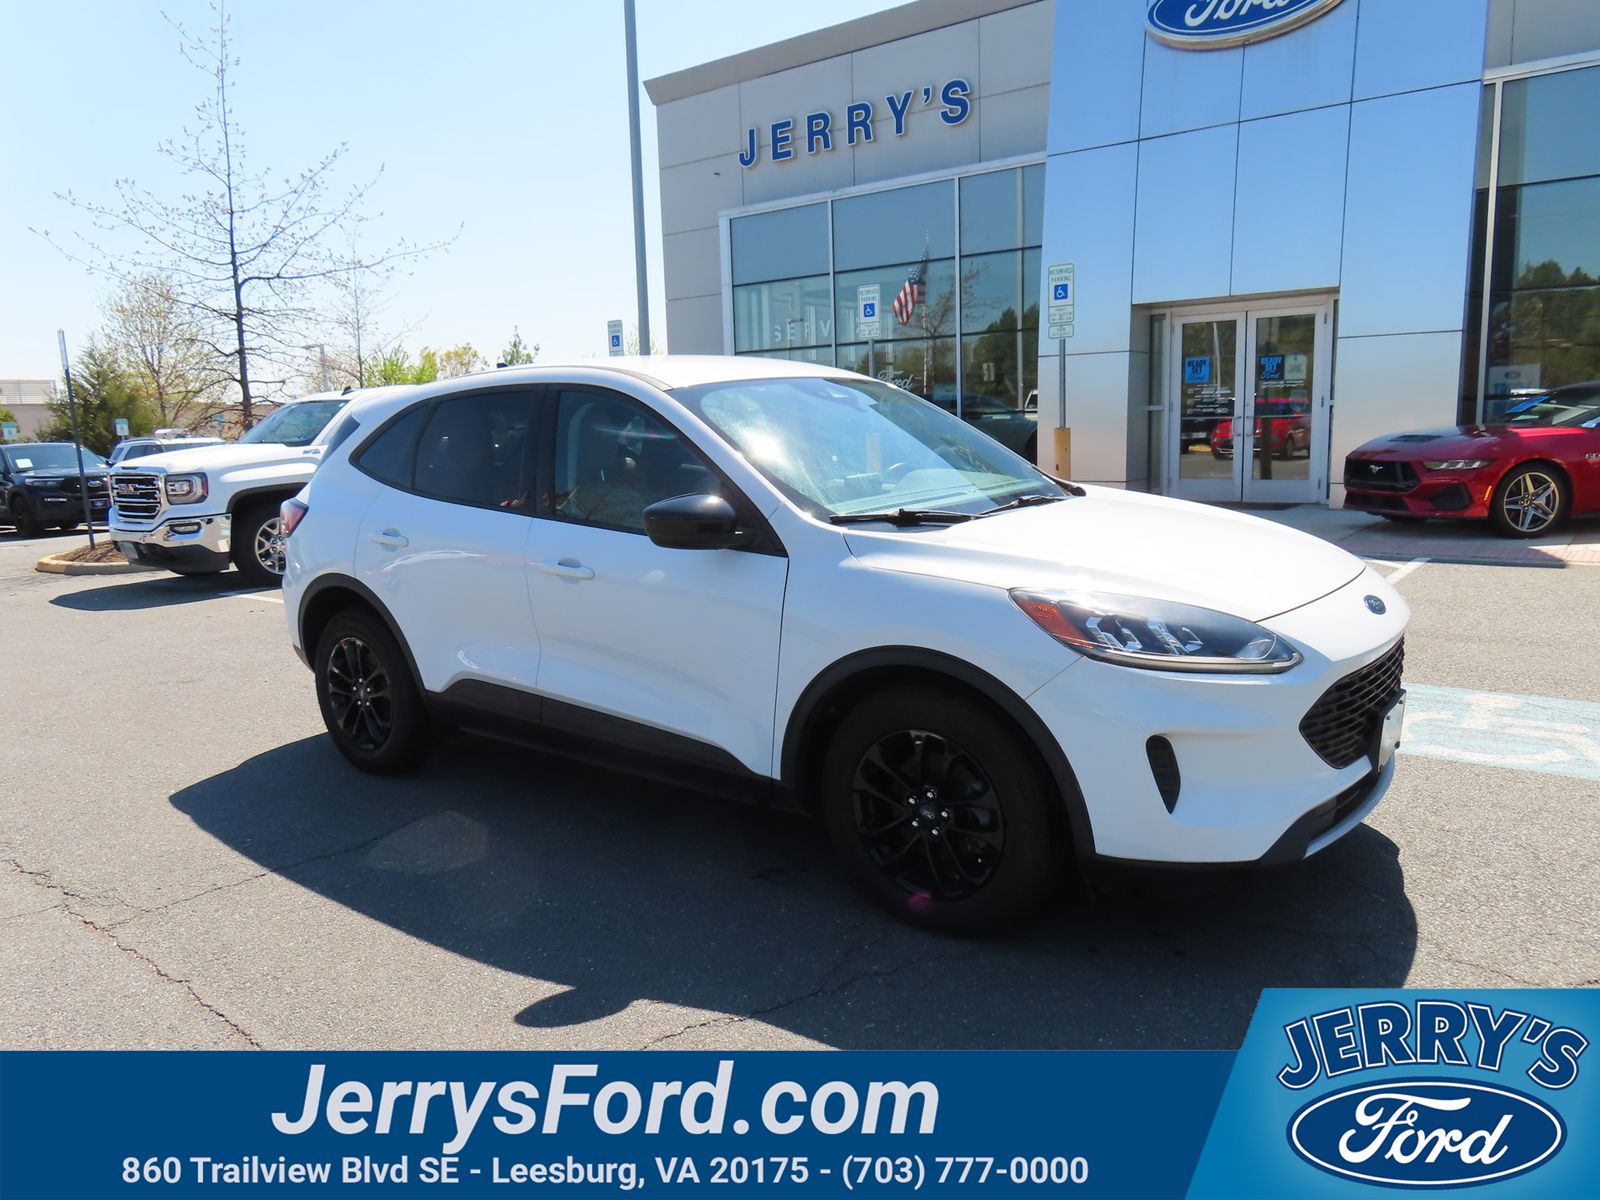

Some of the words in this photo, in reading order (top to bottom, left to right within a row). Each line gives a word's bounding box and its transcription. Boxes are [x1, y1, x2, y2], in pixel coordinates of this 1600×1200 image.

[1184, 0, 1291, 27] For
[738, 78, 971, 169] JERRY'S
[1049, 267, 1073, 276] RESERVED
[1050, 275, 1072, 283] PARKING
